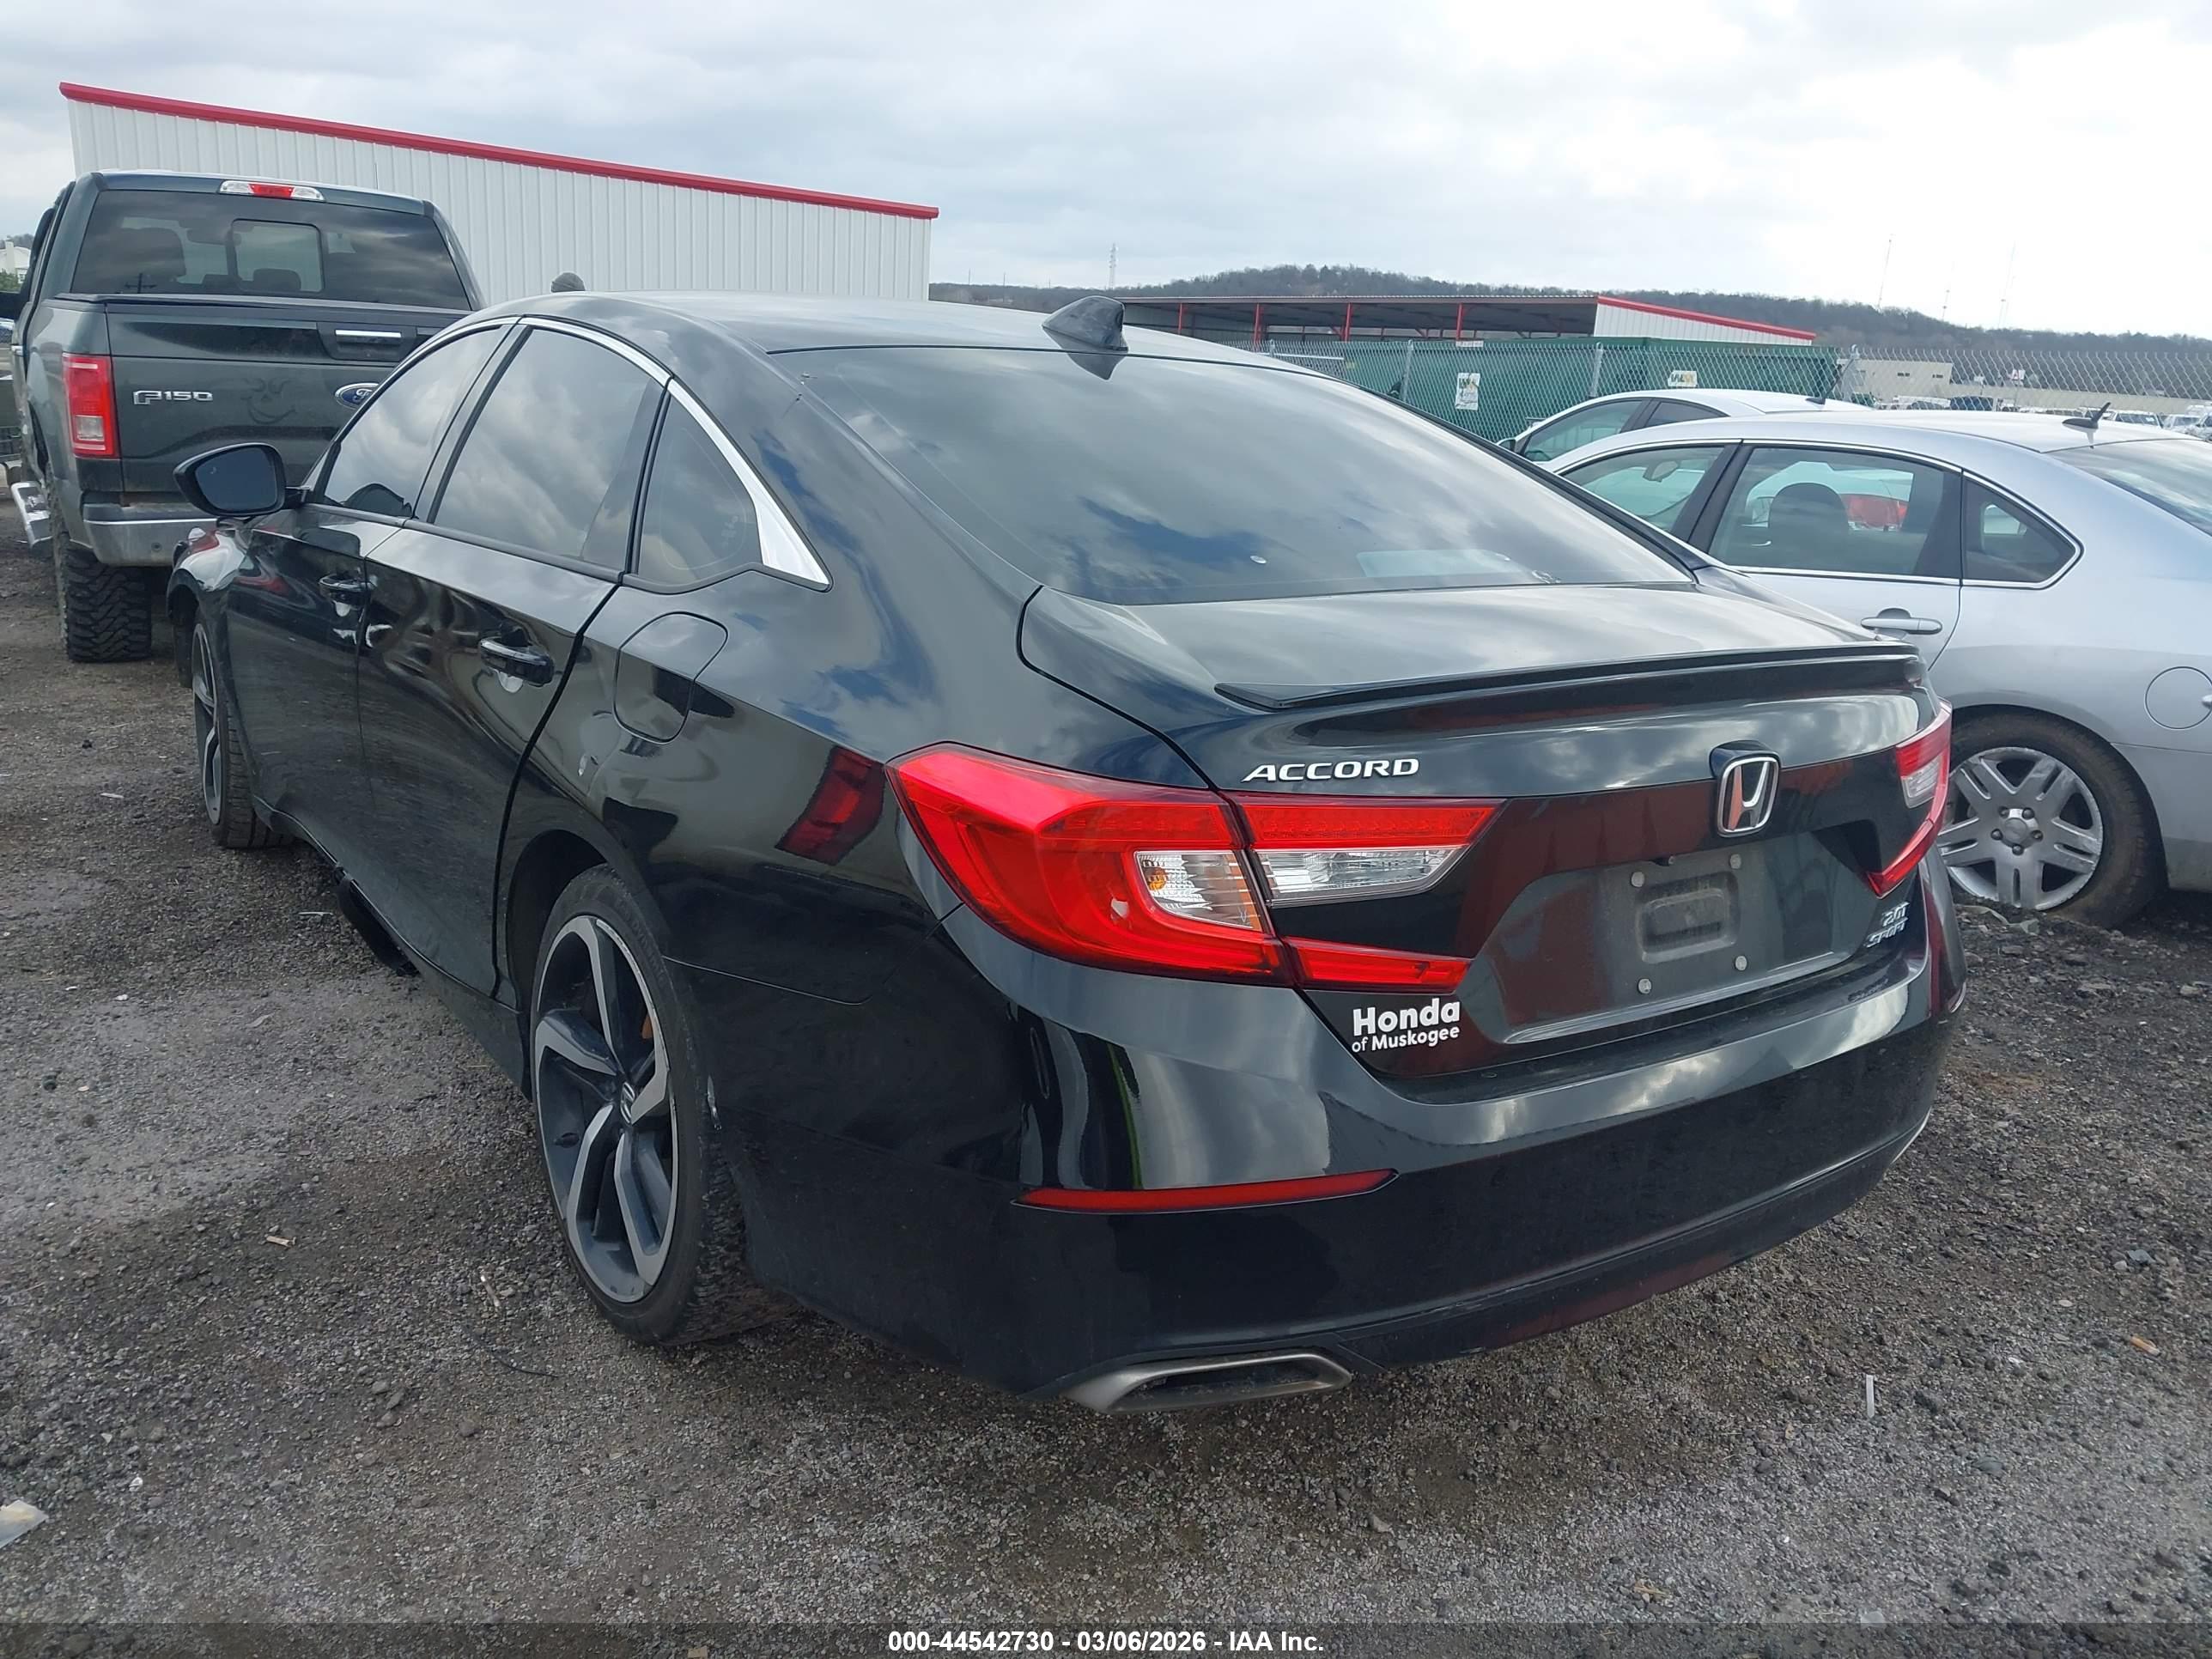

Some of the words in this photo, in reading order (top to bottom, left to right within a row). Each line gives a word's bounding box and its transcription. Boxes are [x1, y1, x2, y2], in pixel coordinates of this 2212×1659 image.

[132, 389, 214, 404] F150
[1241, 758, 1419, 782] ACCORD
[1352, 997, 1461, 1036] Honda
[1352, 1036, 1369, 1053] of
[1371, 1026, 1461, 1051] Muskogee
